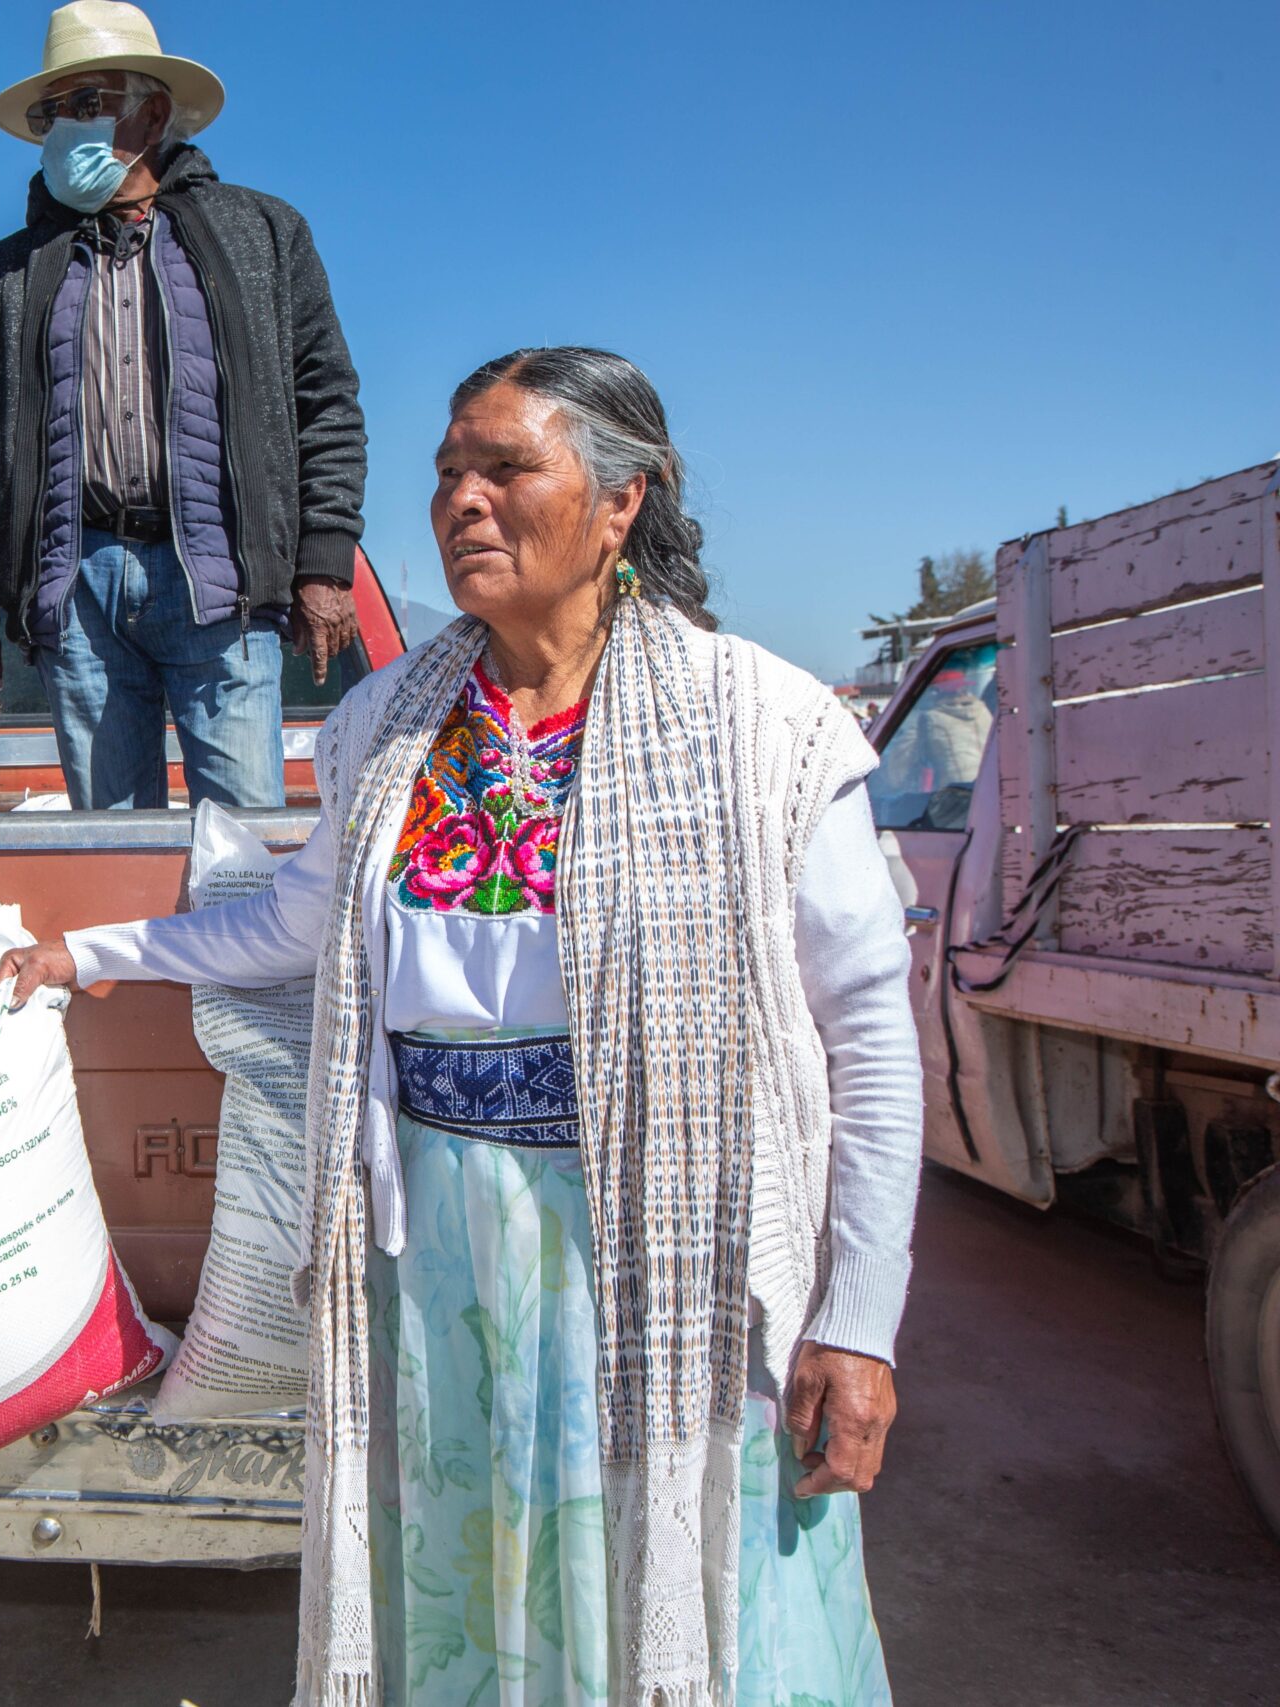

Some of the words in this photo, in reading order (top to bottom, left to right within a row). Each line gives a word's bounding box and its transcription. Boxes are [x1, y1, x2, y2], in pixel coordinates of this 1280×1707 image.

[265, 1071, 306, 1079] PRACTICAS
[261, 1091, 288, 1099] OTROS
[276, 1102, 292, 1110] DEL
[272, 1111, 304, 1120] SUELOS,
[236, 1204, 269, 1220] IRRITACION
[242, 1240, 252, 1248] DE
[243, 1251, 273, 1266] Fertilizante
[9, 1273, 22, 1287] 25
[23, 1265, 38, 1279] Kg
[247, 1305, 267, 1318] aplicar
[234, 1322, 243, 1331] del
[244, 1326, 264, 1338] cultivo
[208, 1334, 241, 1352] GARANTIA:
[210, 1344, 272, 1369] AGROINDUSTRIAS
[273, 1363, 289, 1372] DEL
[102, 1350, 152, 1396] PEMEX
[214, 1357, 255, 1374] formulación
[257, 1369, 262, 1377] y
[195, 1380, 207, 1390] sus
[211, 1376, 239, 1387] nuestro
